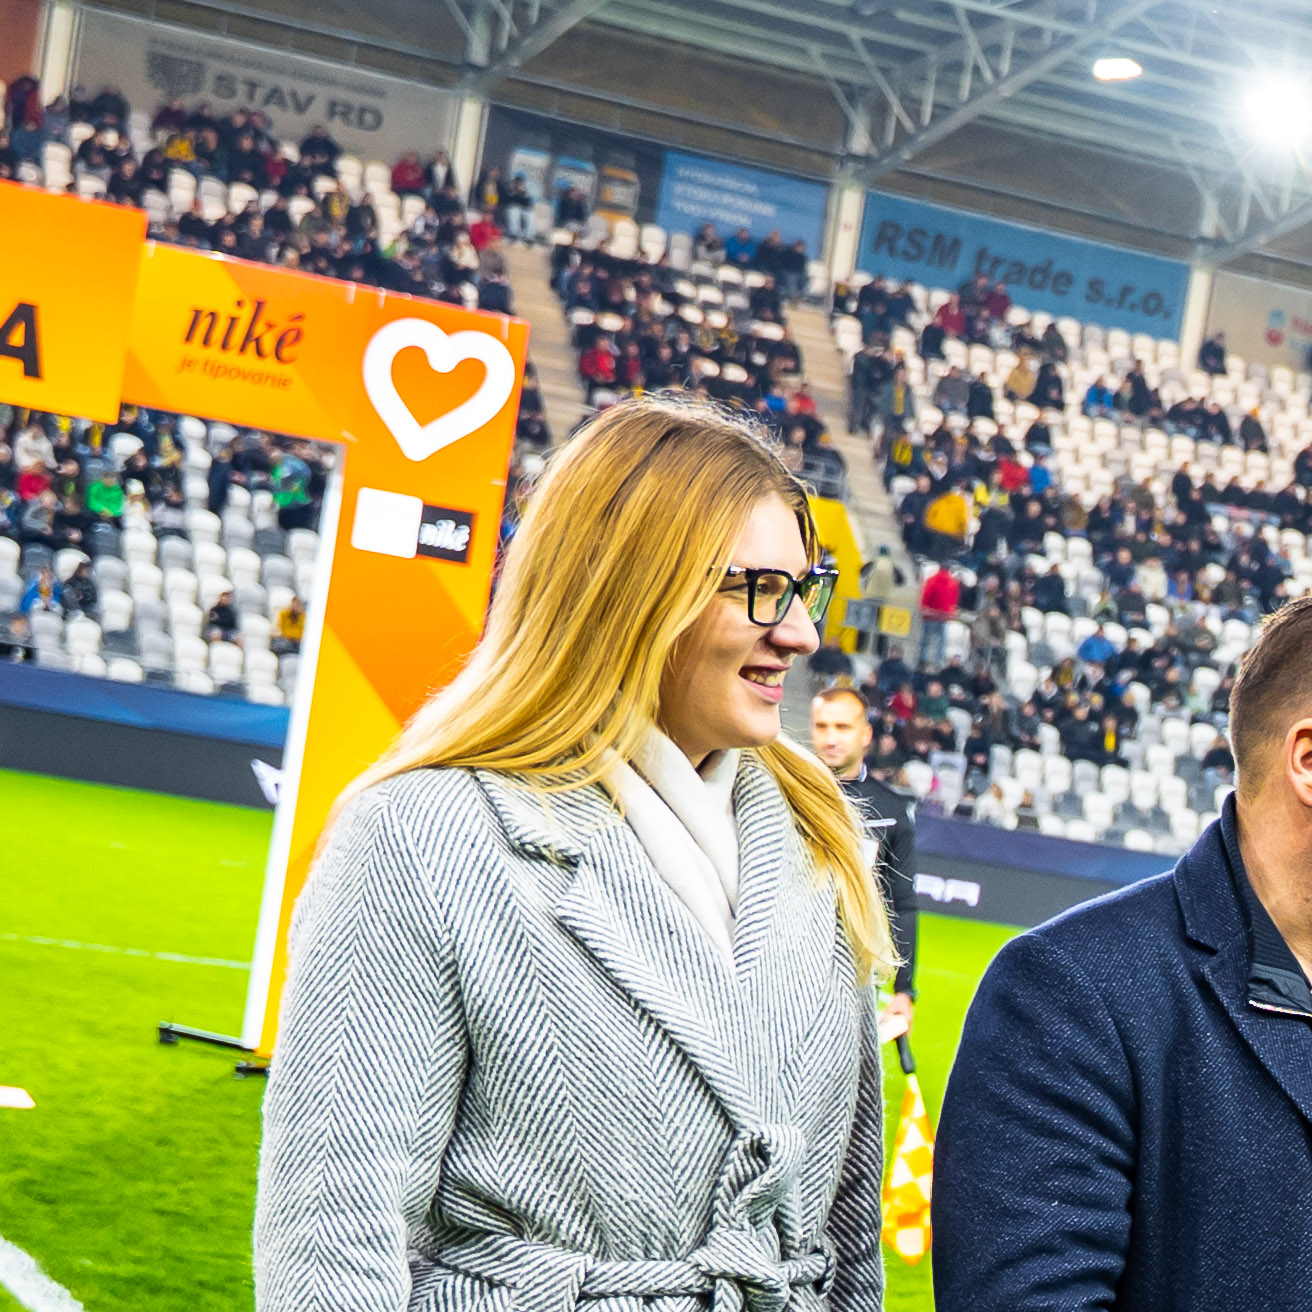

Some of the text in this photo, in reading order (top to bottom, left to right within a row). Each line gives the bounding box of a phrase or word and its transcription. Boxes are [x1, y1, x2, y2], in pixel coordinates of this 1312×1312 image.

[213, 72, 317, 117] STAV
[327, 100, 384, 132] RD
[873, 219, 1172, 320] RSM trade s.r.o.
[184, 298, 306, 365] niké
